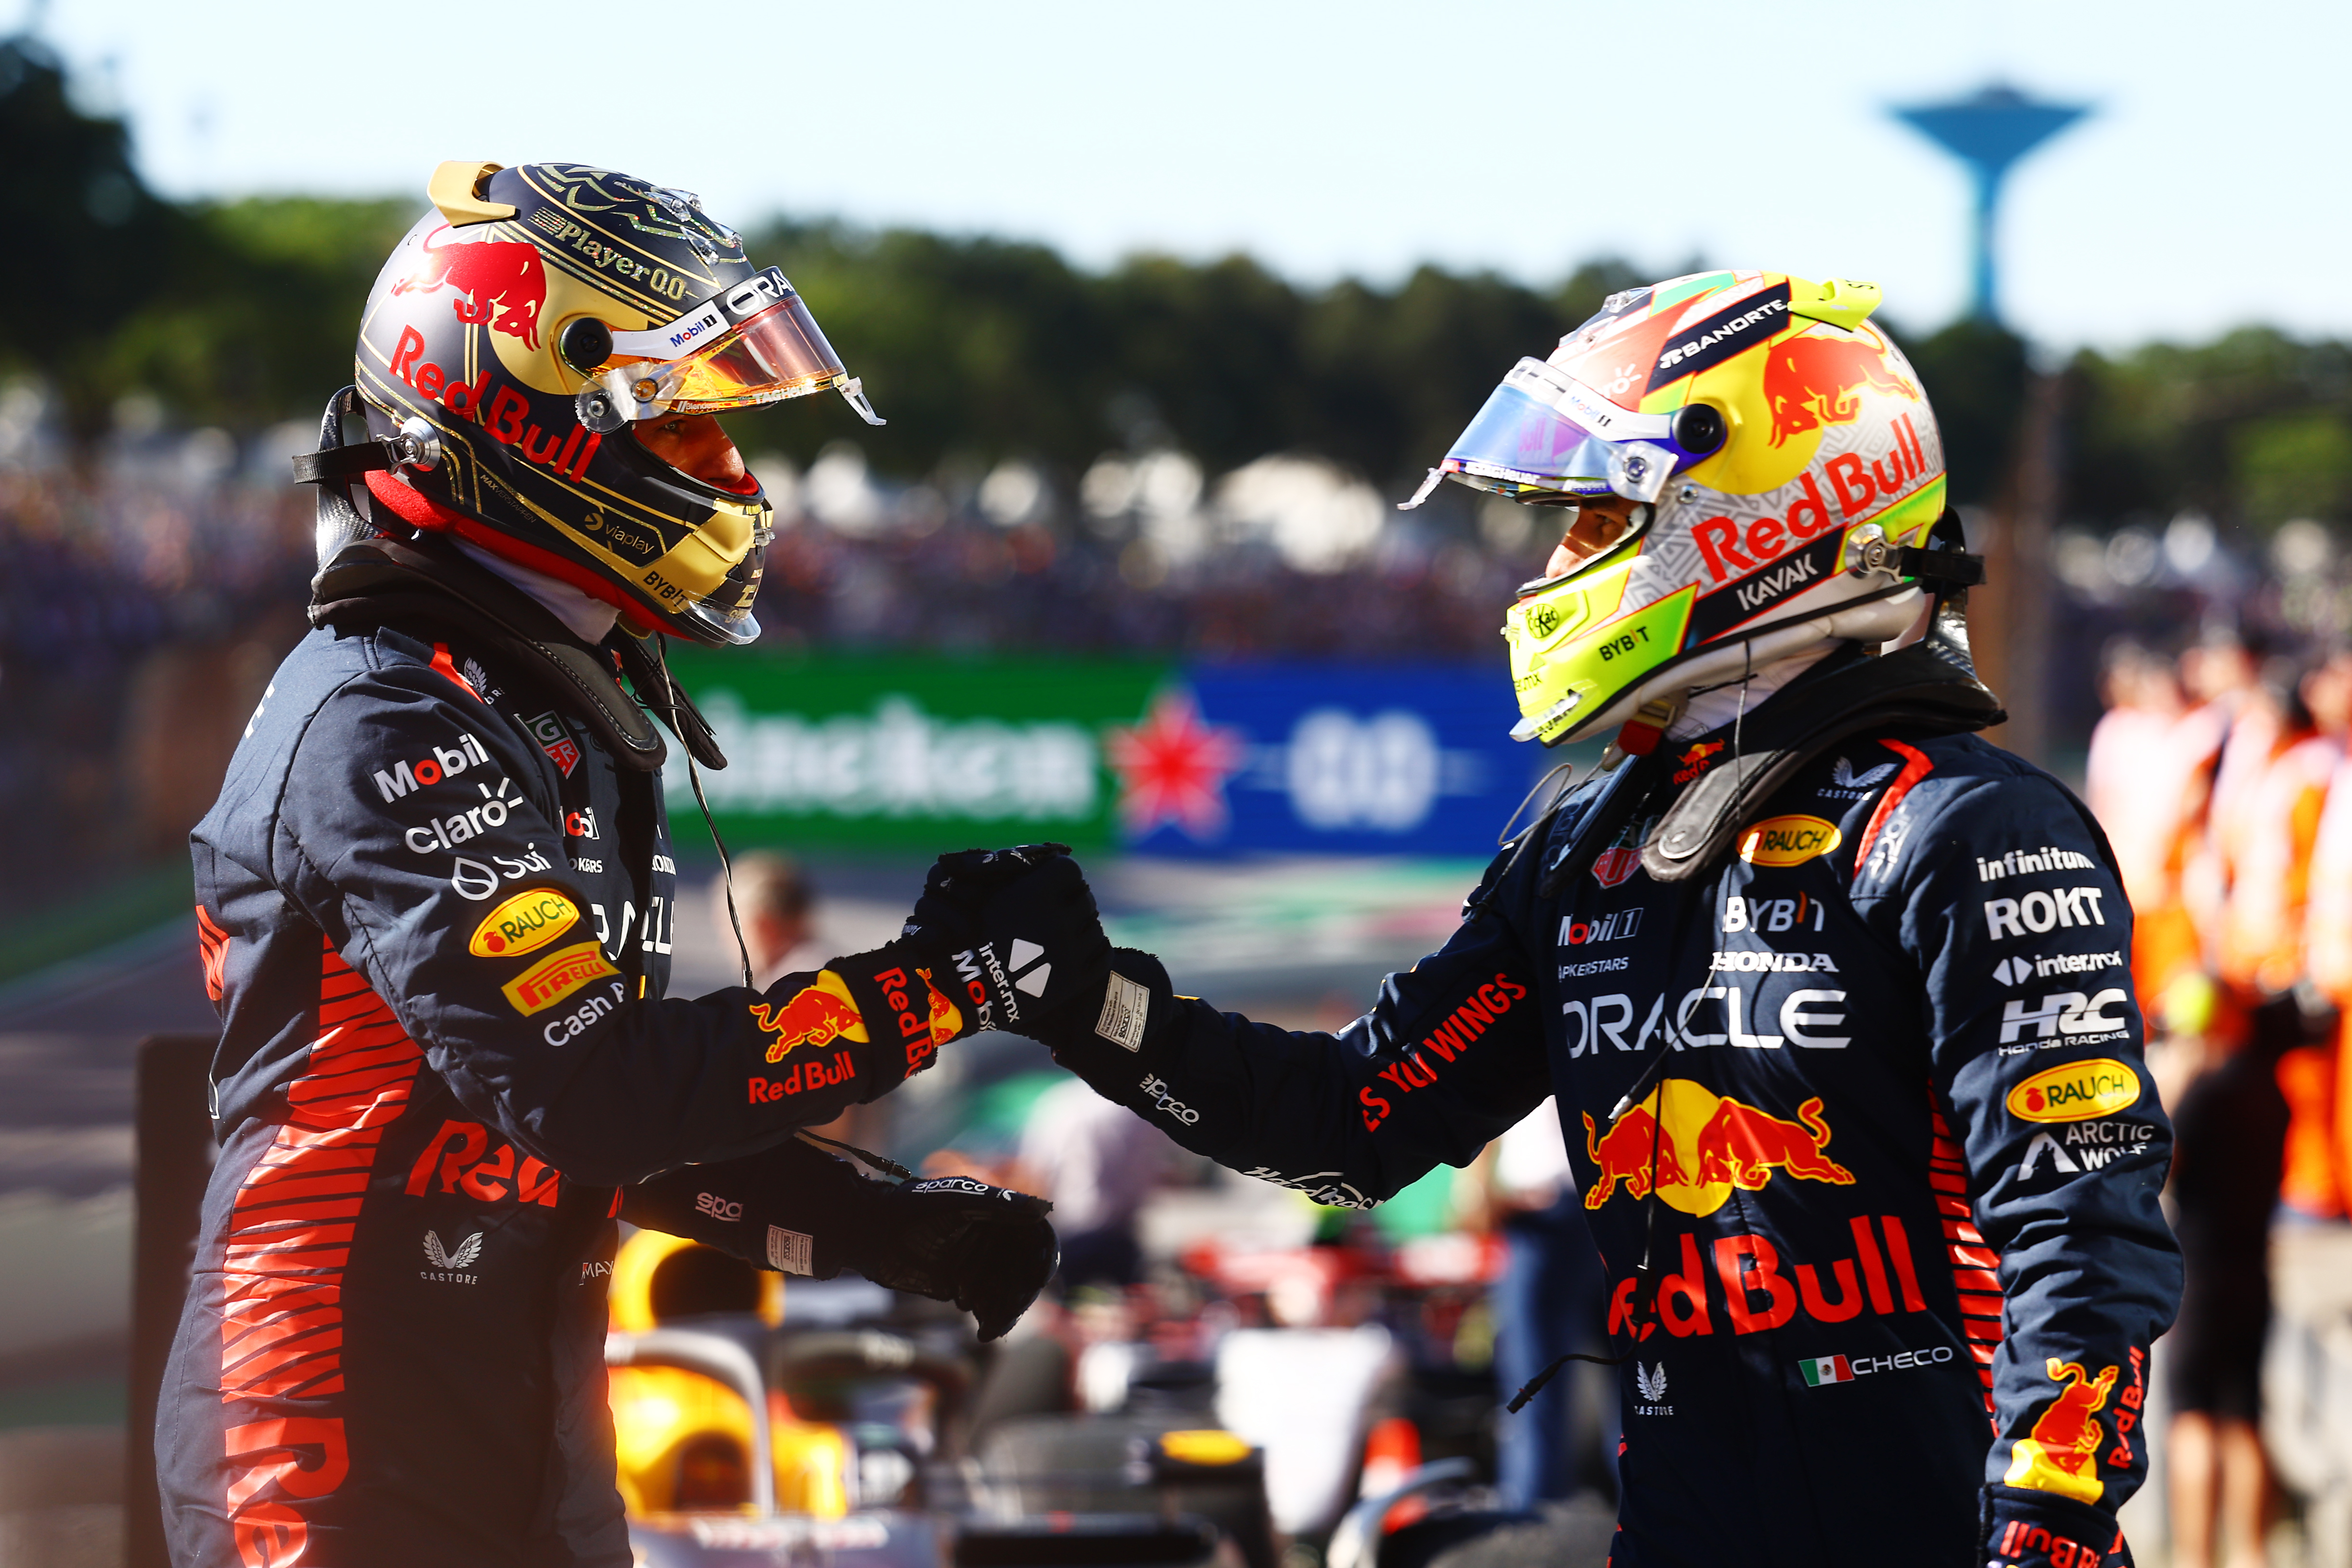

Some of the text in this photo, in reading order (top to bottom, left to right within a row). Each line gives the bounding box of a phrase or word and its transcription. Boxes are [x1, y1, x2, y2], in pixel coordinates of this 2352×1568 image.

[555, 219, 649, 281] Player
[670, 321, 705, 347] Mobil
[1682, 299, 1787, 358] BANORTE
[388, 324, 601, 484] Red Bull
[1691, 412, 1926, 582] Red Bull
[605, 525, 655, 554] viaplay
[1736, 554, 1818, 611] KAVAK
[1599, 627, 1650, 661] BYBIT
[373, 733, 490, 804] Mobil
[492, 842, 552, 880] Sui
[1763, 830, 1823, 852] RAUCH
[500, 896, 571, 944] RAUCH
[1984, 886, 2105, 940] ROKT
[516, 950, 607, 1008] PIRELLI
[978, 941, 1020, 1023] inter.mx
[1709, 950, 1840, 972] HONDA
[2035, 951, 2122, 977] inter.mx
[544, 999, 613, 1047] Cash
[873, 967, 929, 1038] Red
[1422, 973, 1527, 1063] WINGS
[1563, 986, 1851, 1058] ORACLE
[2000, 988, 2127, 1043] HRC
[2065, 1029, 2129, 1046] RACING
[748, 1051, 856, 1104] Red Bull
[2047, 1074, 2125, 1107] RAUCH
[2065, 1122, 2154, 1145] ARCTIC
[913, 1179, 989, 1194] sparco
[421, 1271, 478, 1285] CASTORE
[1715, 1214, 1928, 1336] Bull
[1852, 1346, 1953, 1376] CHECO
